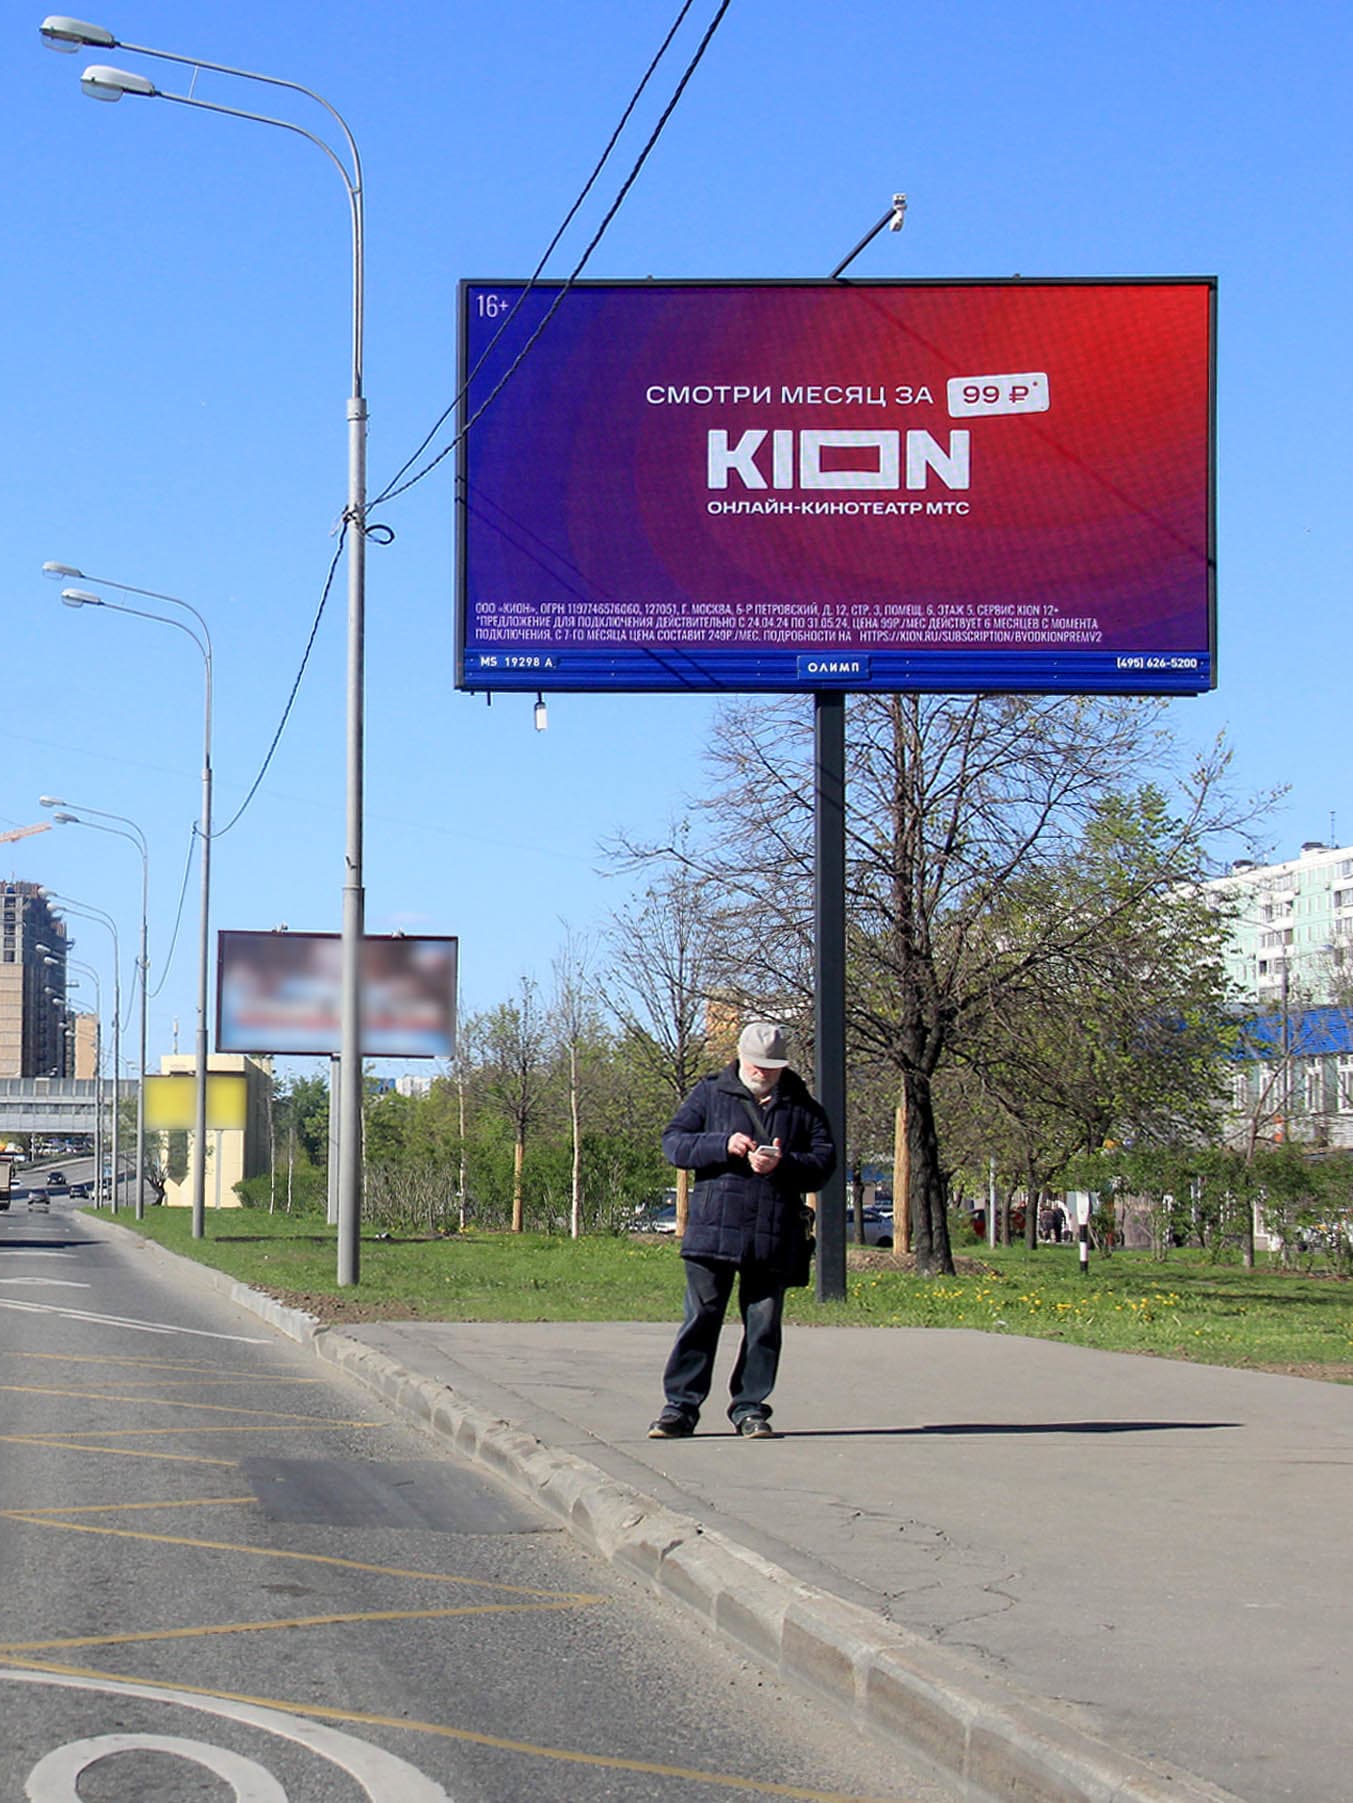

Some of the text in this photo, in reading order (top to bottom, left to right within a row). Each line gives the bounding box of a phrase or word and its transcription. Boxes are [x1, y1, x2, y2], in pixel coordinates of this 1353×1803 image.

[476, 294, 508, 317] 16+
[646, 385, 770, 404] СМОТРИ
[780, 385, 886, 406] МЕСЯЦ
[896, 385, 933, 404] ЗА
[963, 385, 999, 403] 99
[707, 429, 970, 490] KION
[707, 498, 970, 515] ОНЛАЙН-КИНОТЕАТР МТС
[475, 603, 495, 615] ООО
[540, 603, 564, 615] ОГРН
[937, 604, 963, 616] ЭТАЖ
[977, 604, 1014, 616] СЕРВИС
[553, 616, 575, 629] ДЛЯ
[578, 616, 652, 629] ПОДКЛЮЧЕНИЯ
[656, 615, 735, 629] ДЕЙСТВИТЕЛЬНО
[738, 616, 745, 628] С
[791, 617, 805, 629] ПО
[852, 617, 878, 630] ЦЕНА
[928, 616, 982, 630] ДЕЙСТВУЕТ
[984, 617, 990, 629] 6
[993, 617, 1039, 630] МЕСЯЦЕВ
[1041, 617, 1048, 629] С
[1051, 617, 1097, 629] МОМЕНТА
[554, 629, 562, 641] С
[587, 629, 625, 642] МЕСЯЦА
[629, 629, 655, 642] ЦЕНА
[657, 629, 705, 641] СОСТАВИТ
[763, 630, 835, 643] ПОДРОБНОСТИ
[838, 630, 851, 642] НА
[480, 657, 497, 667] MS
[505, 657, 540, 667] 19298
[807, 662, 859, 672] ОЛИМП
[1116, 657, 1197, 668] (495) 626-5200
